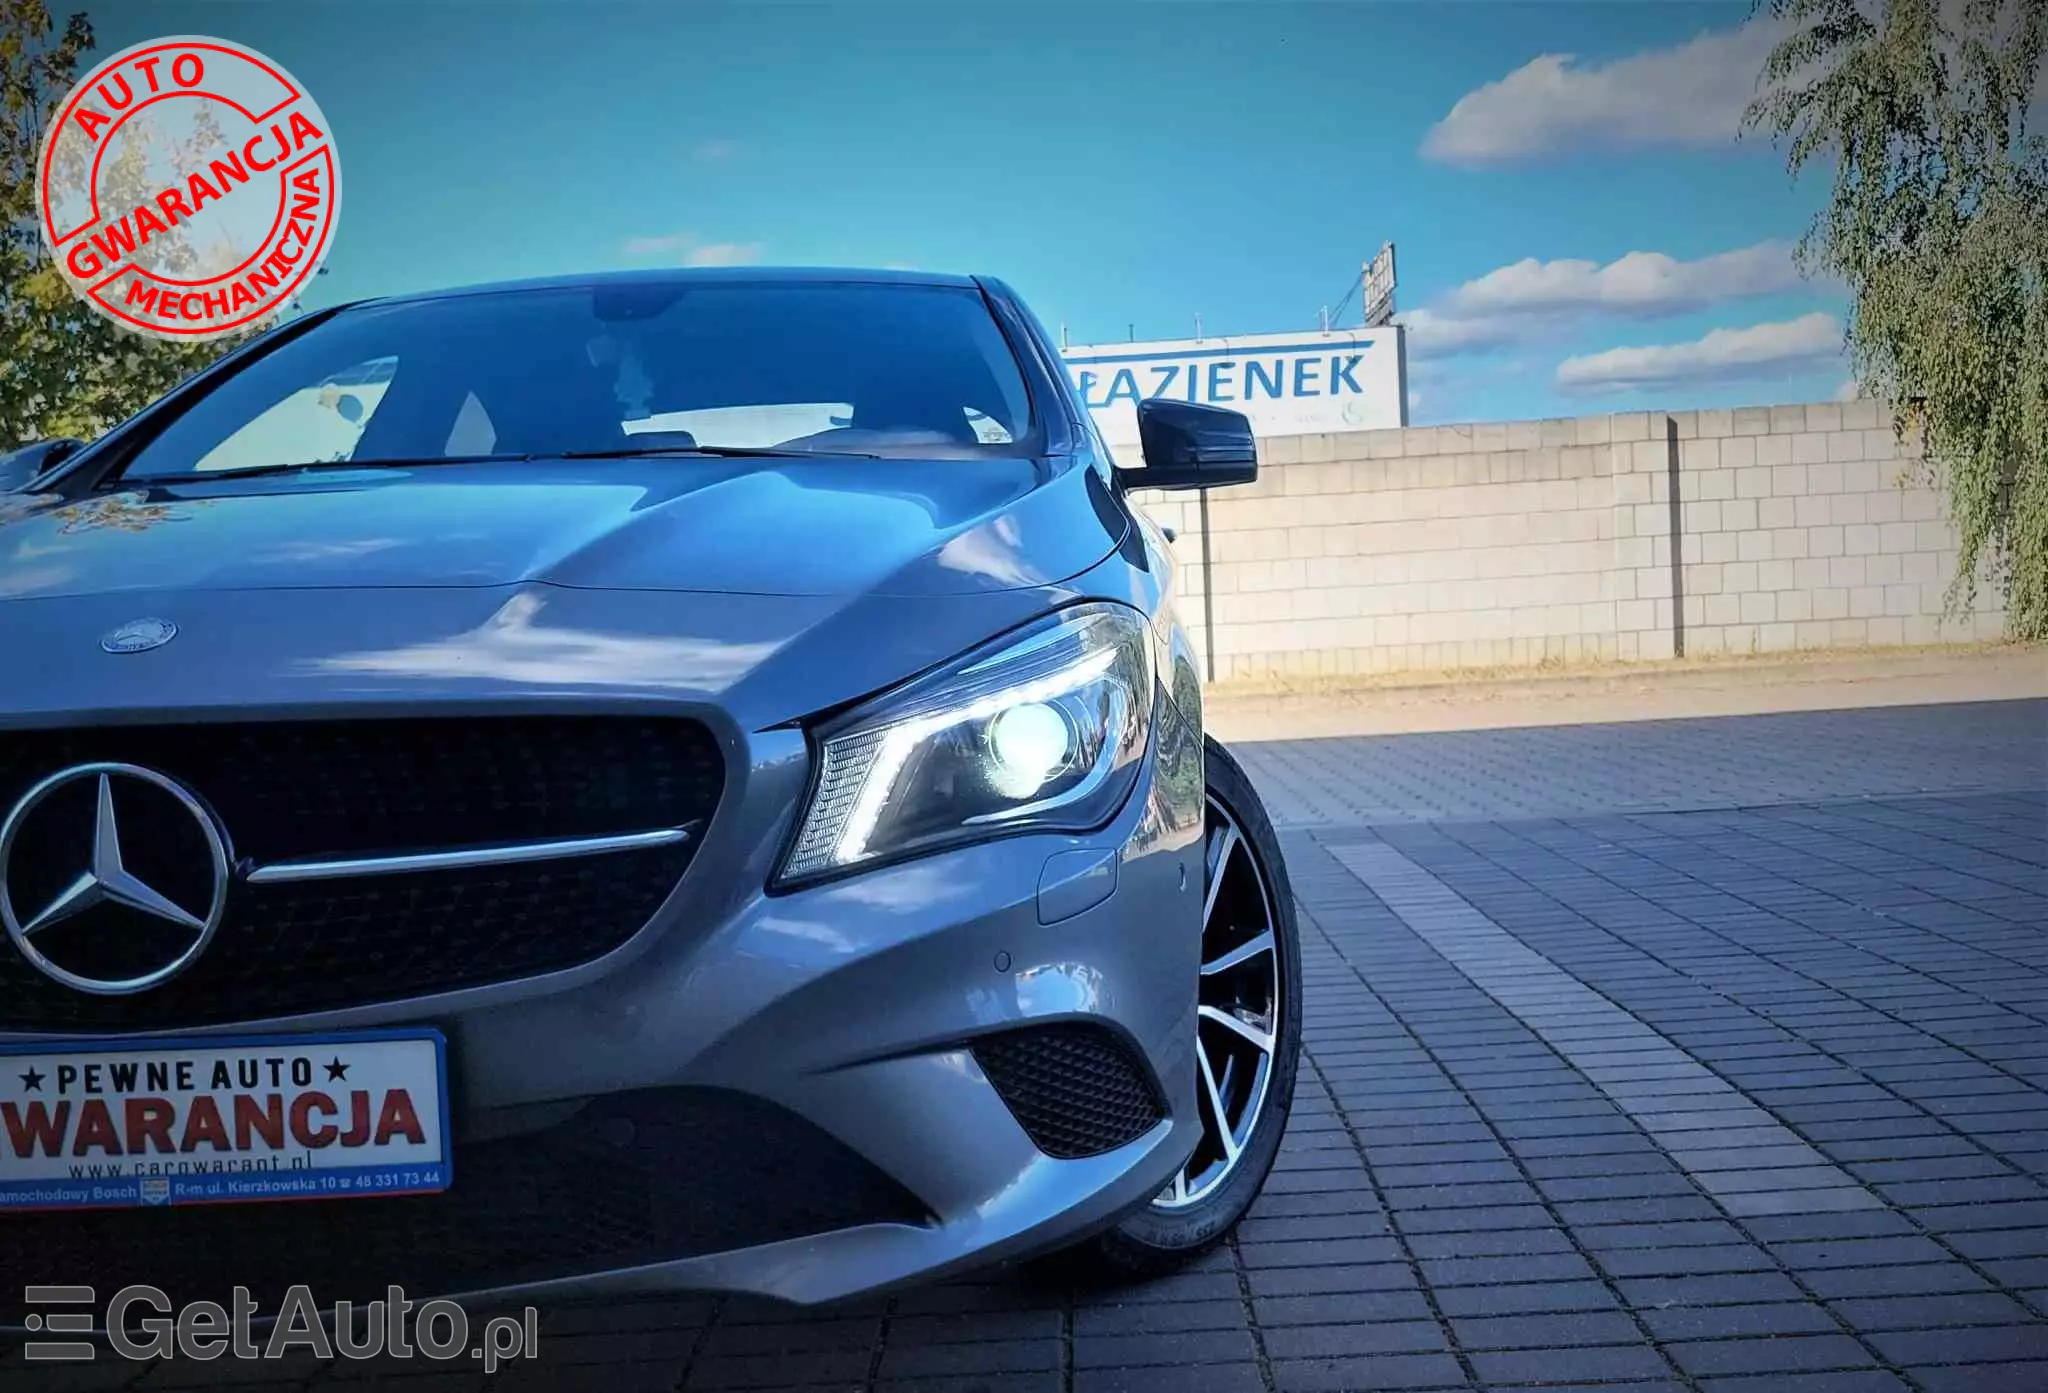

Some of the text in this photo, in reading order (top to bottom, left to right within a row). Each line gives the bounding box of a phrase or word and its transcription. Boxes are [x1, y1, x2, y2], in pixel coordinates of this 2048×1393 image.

[57, 1056, 312, 1095] PEWNE AUTO
[93, 1185, 137, 1200] Bosch
[207, 1181, 224, 1195] ul.
[228, 1177, 316, 1194] Kierzkowska
[320, 1176, 336, 1189] 10
[356, 1175, 372, 1188] 48
[375, 1173, 399, 1186] 331
[404, 1172, 420, 1185] 73
[423, 1171, 440, 1184] 44
